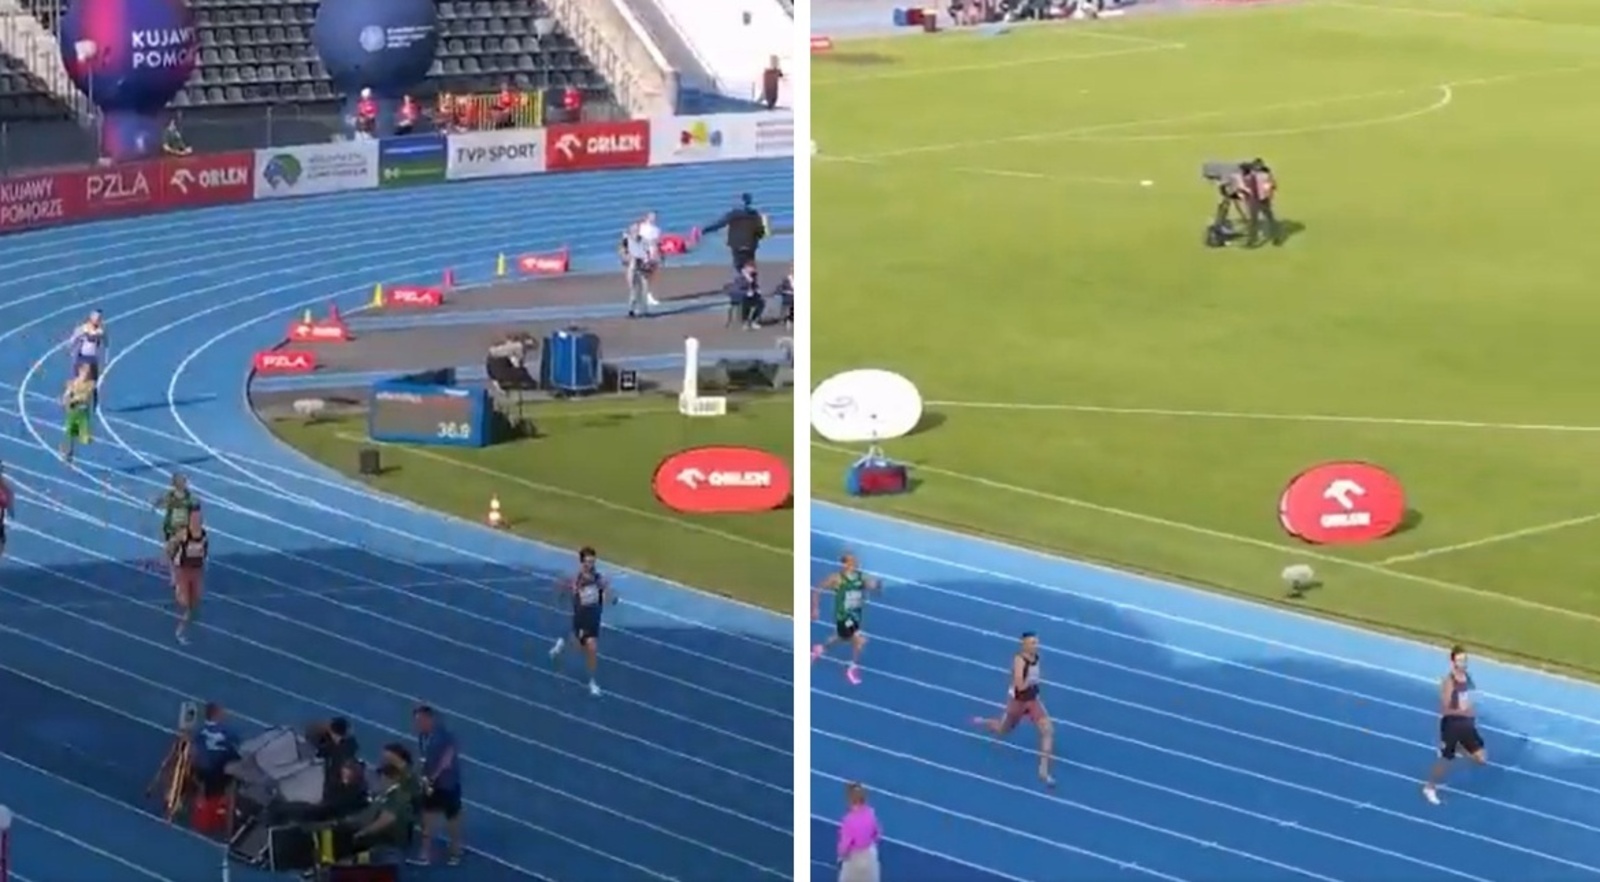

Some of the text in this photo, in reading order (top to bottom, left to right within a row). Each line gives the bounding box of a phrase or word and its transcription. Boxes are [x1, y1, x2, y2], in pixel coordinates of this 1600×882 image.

[457, 148, 487, 163] TVP
[490, 143, 537, 162] SPORT
[587, 134, 643, 153] ORLEN
[87, 171, 150, 200] PZLA
[199, 167, 247, 187] ORLEN
[0, 177, 53, 200] KUJAWY
[0, 198, 64, 224] POMORZE
